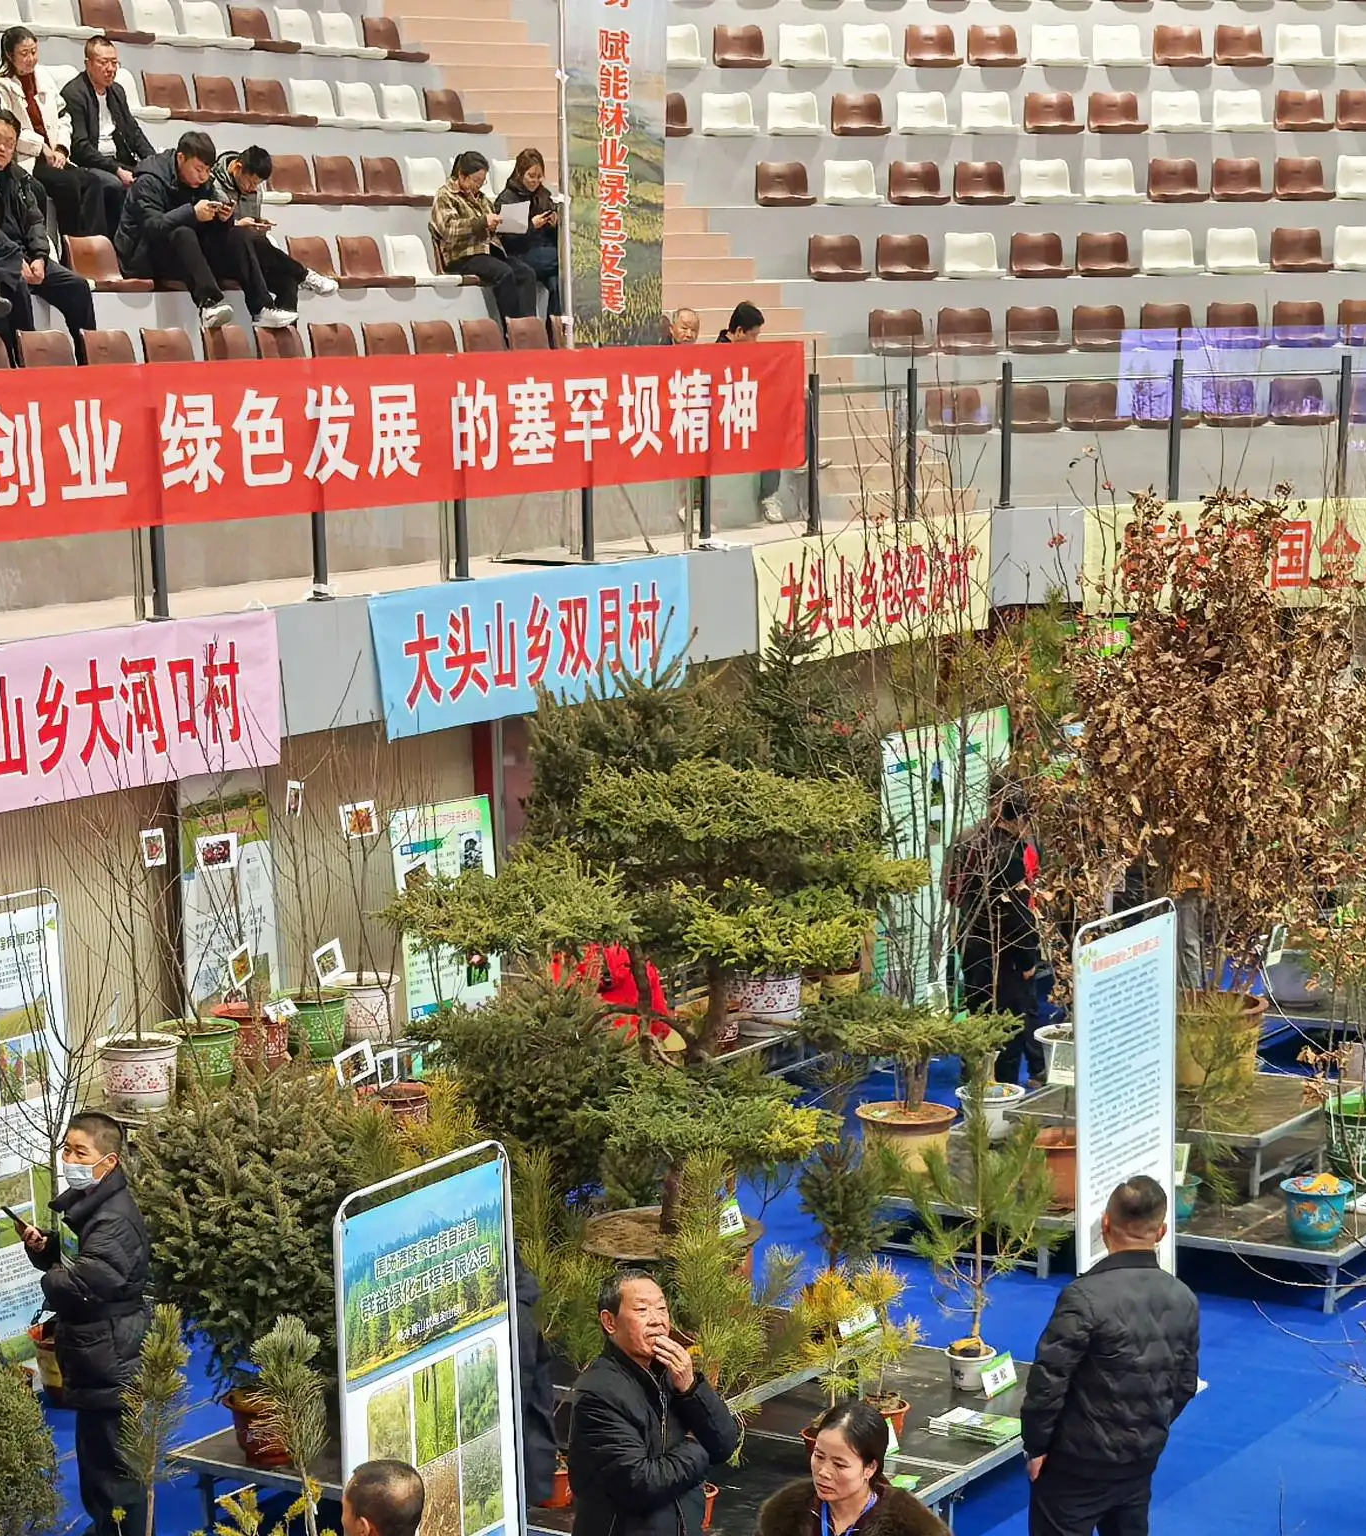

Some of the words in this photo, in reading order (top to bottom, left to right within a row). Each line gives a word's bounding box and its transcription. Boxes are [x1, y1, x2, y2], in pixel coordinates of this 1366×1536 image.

[597, 28, 631, 314] 赋能林业绿色发展
[161, 383, 422, 490] 绿色发展
[450, 366, 759, 472] 的塞罕坝精神
[401, 582, 662, 710] 大头山乡双月村
